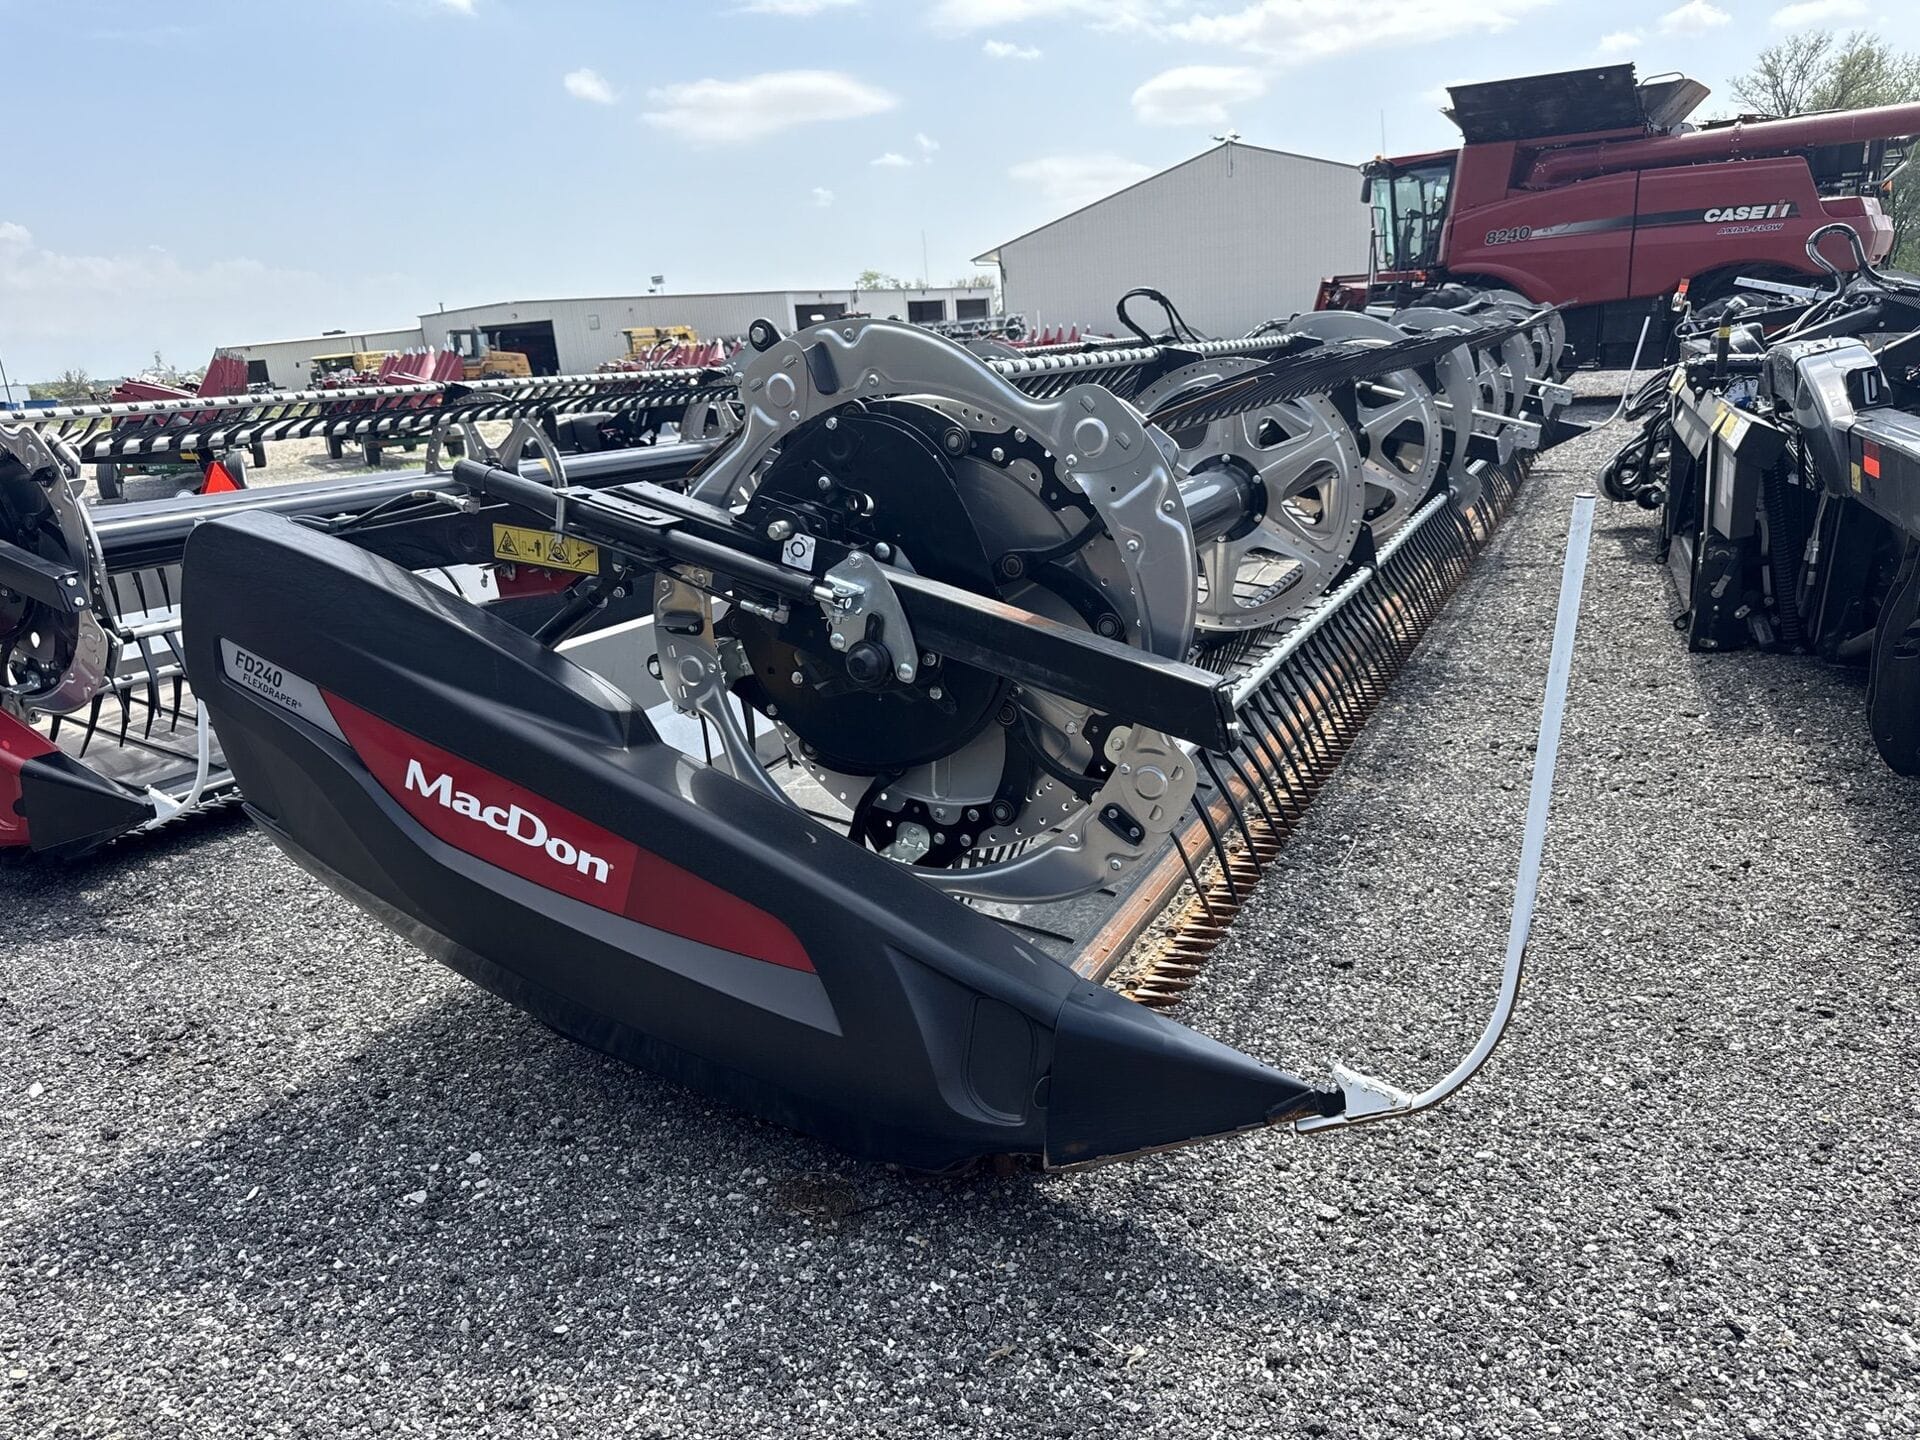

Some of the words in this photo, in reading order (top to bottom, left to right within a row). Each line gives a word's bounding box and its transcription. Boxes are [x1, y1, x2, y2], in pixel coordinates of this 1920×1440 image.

[1703, 205, 1768, 223] CASE
[1484, 225, 1531, 246] 8240
[1716, 223, 1784, 235] AXIAL-FLOW
[235, 650, 283, 688] FD240
[404, 758, 610, 884] MacDon
